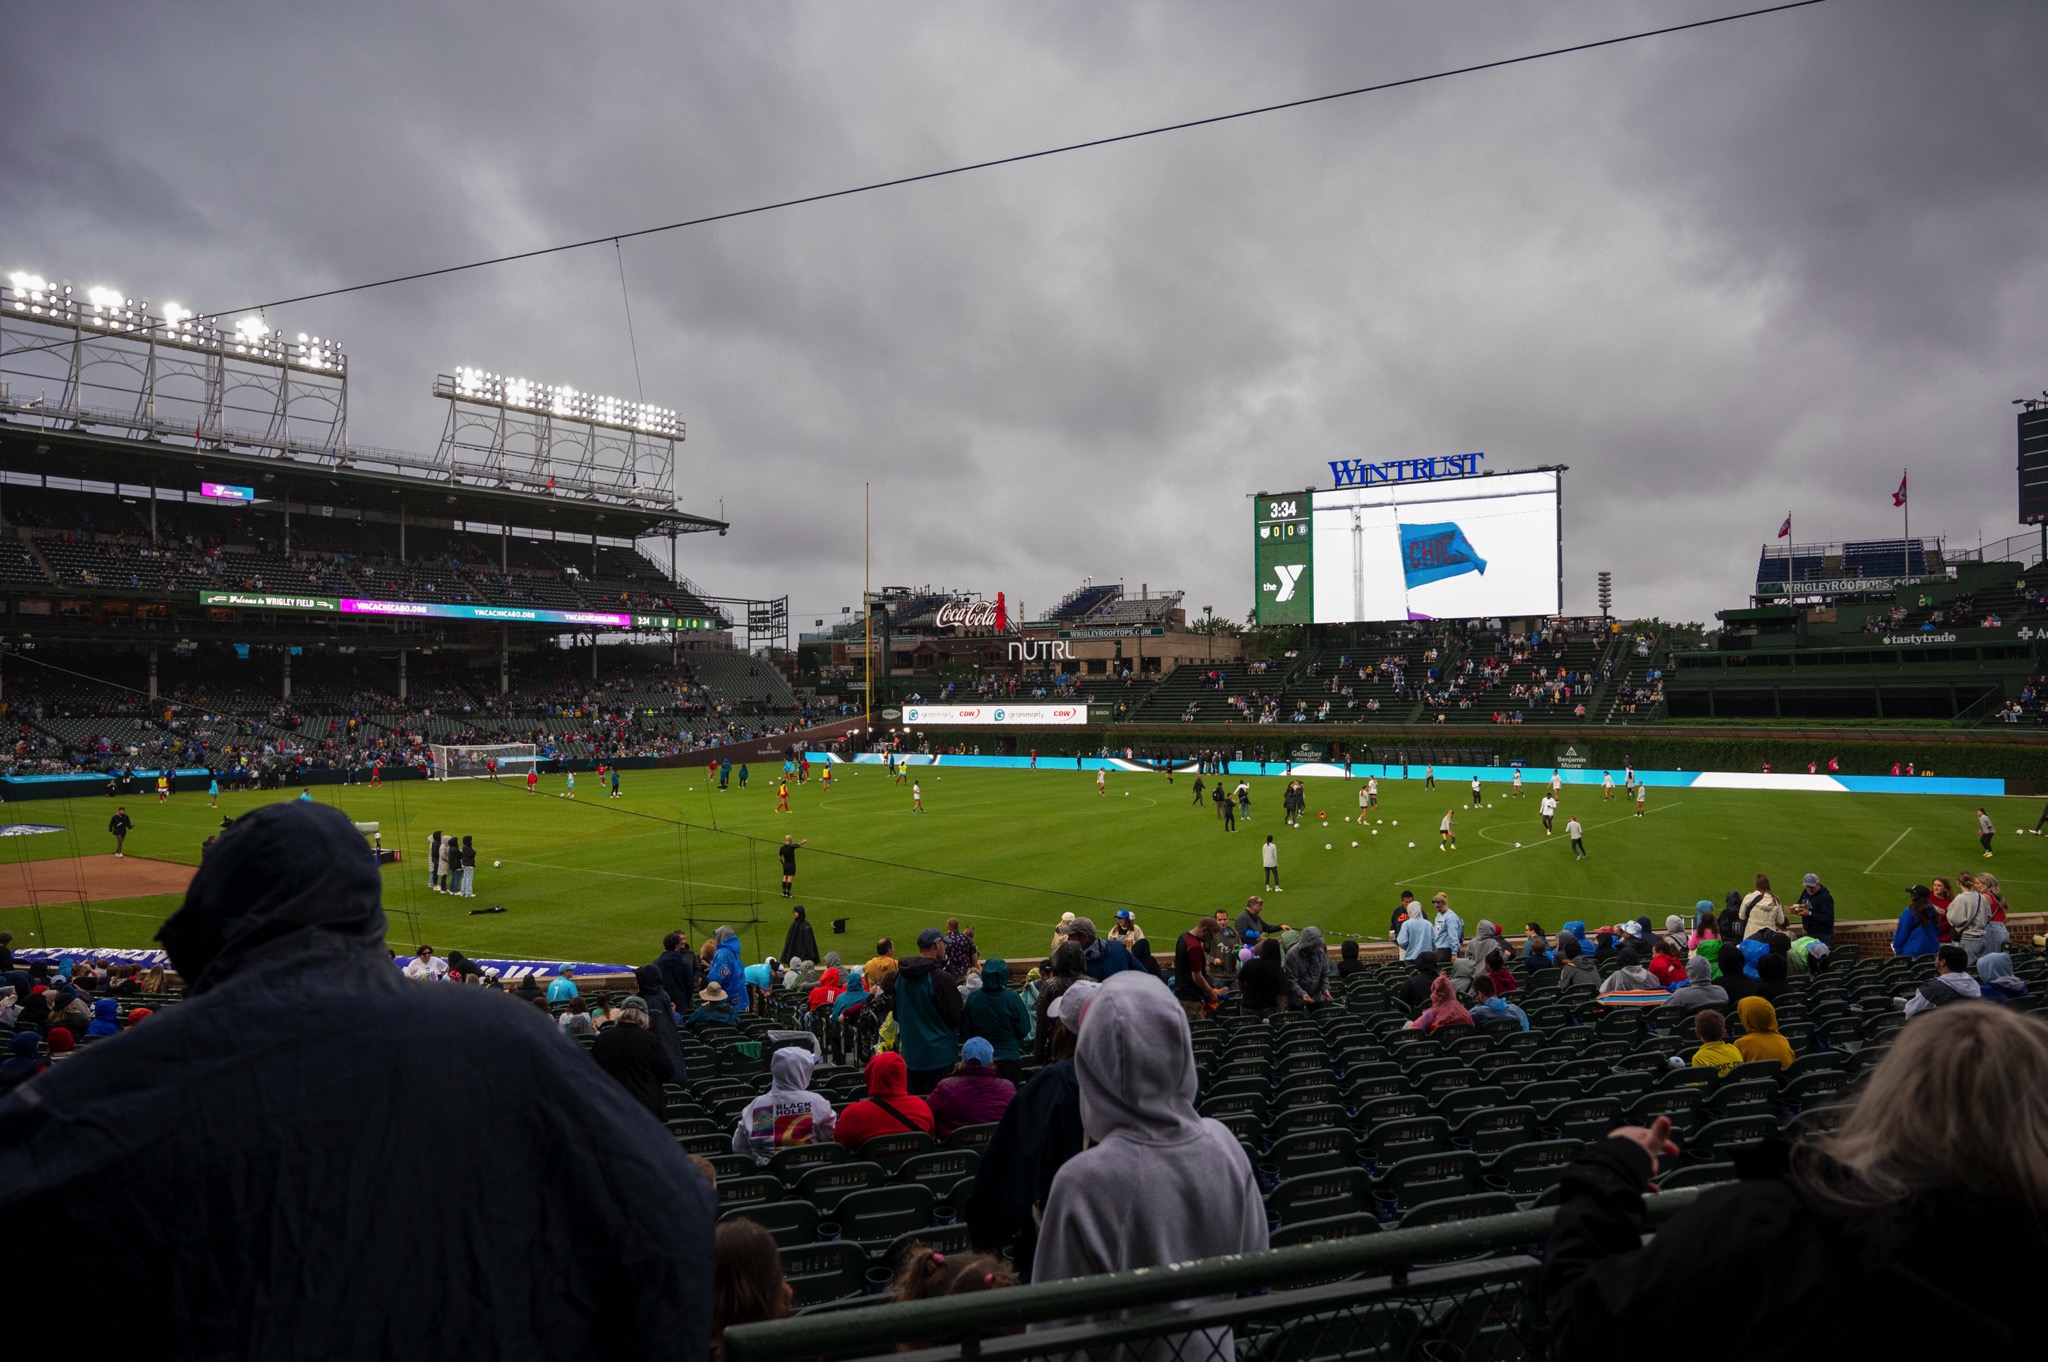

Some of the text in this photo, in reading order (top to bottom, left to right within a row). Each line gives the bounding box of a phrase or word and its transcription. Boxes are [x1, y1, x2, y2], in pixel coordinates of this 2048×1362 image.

[1270, 501, 1297, 518] 3:34
[1273, 524, 1294, 537] 0 0
[1263, 582, 1277, 591] the
[229, 595, 257, 605] Welcome
[265, 597, 295, 607] WRIGLEY
[295, 599, 315, 608] FIELD
[356, 602, 427, 614] YMCACHICAGO.ORG
[474, 609, 536, 619] YMCACHICAGO.ORG
[936, 600, 1000, 628] Coca-Cola
[637, 616, 650, 626] 3:34
[1891, 632, 1957, 645] tastytrade
[1008, 710, 1045, 719] grammarly
[1291, 750, 1322, 758] Gallagher
[1557, 756, 1587, 764] Benjamin
[776, 1101, 812, 1110] BLACK
[776, 1107, 812, 1116] HOLES
